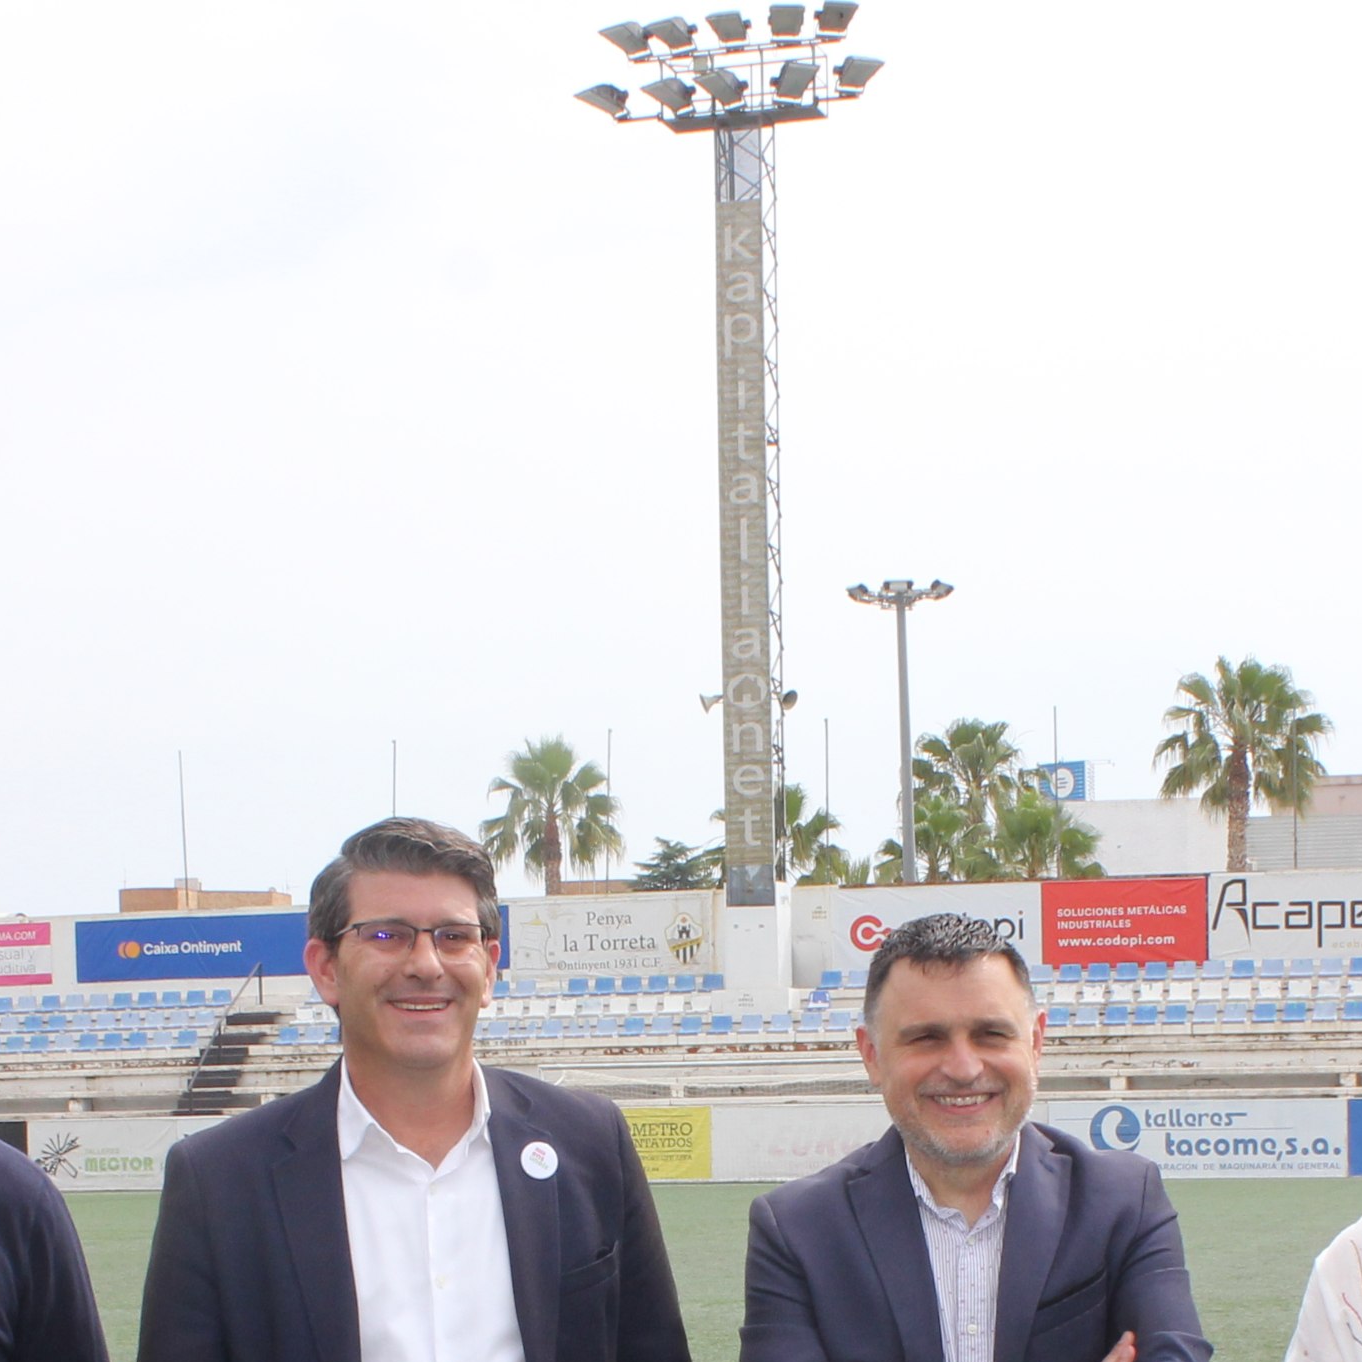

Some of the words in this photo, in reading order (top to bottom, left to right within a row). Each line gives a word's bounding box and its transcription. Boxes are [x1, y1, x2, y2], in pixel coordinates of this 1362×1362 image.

[731, 721, 764, 848] net
[1057, 907, 1124, 918] SOLUCIONES
[1126, 904, 1187, 916] METÁLICAS
[586, 911, 632, 929] Penya
[1057, 919, 1132, 930] INDUSTRIALES
[142, 942, 179, 956] Caixa
[180, 940, 243, 956] Ontinyent
[562, 935, 578, 953] la
[584, 934, 657, 952] Torreta
[1058, 934, 1175, 948] www.codopi.com
[28, 949, 36, 963] y
[557, 959, 611, 973] Ontinyent
[614, 958, 639, 970] 1931
[1144, 1108, 1248, 1128] talleres
[628, 1122, 693, 1137] METRO
[633, 1137, 693, 1149] NTAYDOS
[1203, 1162, 1215, 1171] DE
[1219, 1162, 1278, 1172] MAQUINARIA
[1281, 1162, 1294, 1171] EN
[1297, 1162, 1342, 1171] GENERAL
